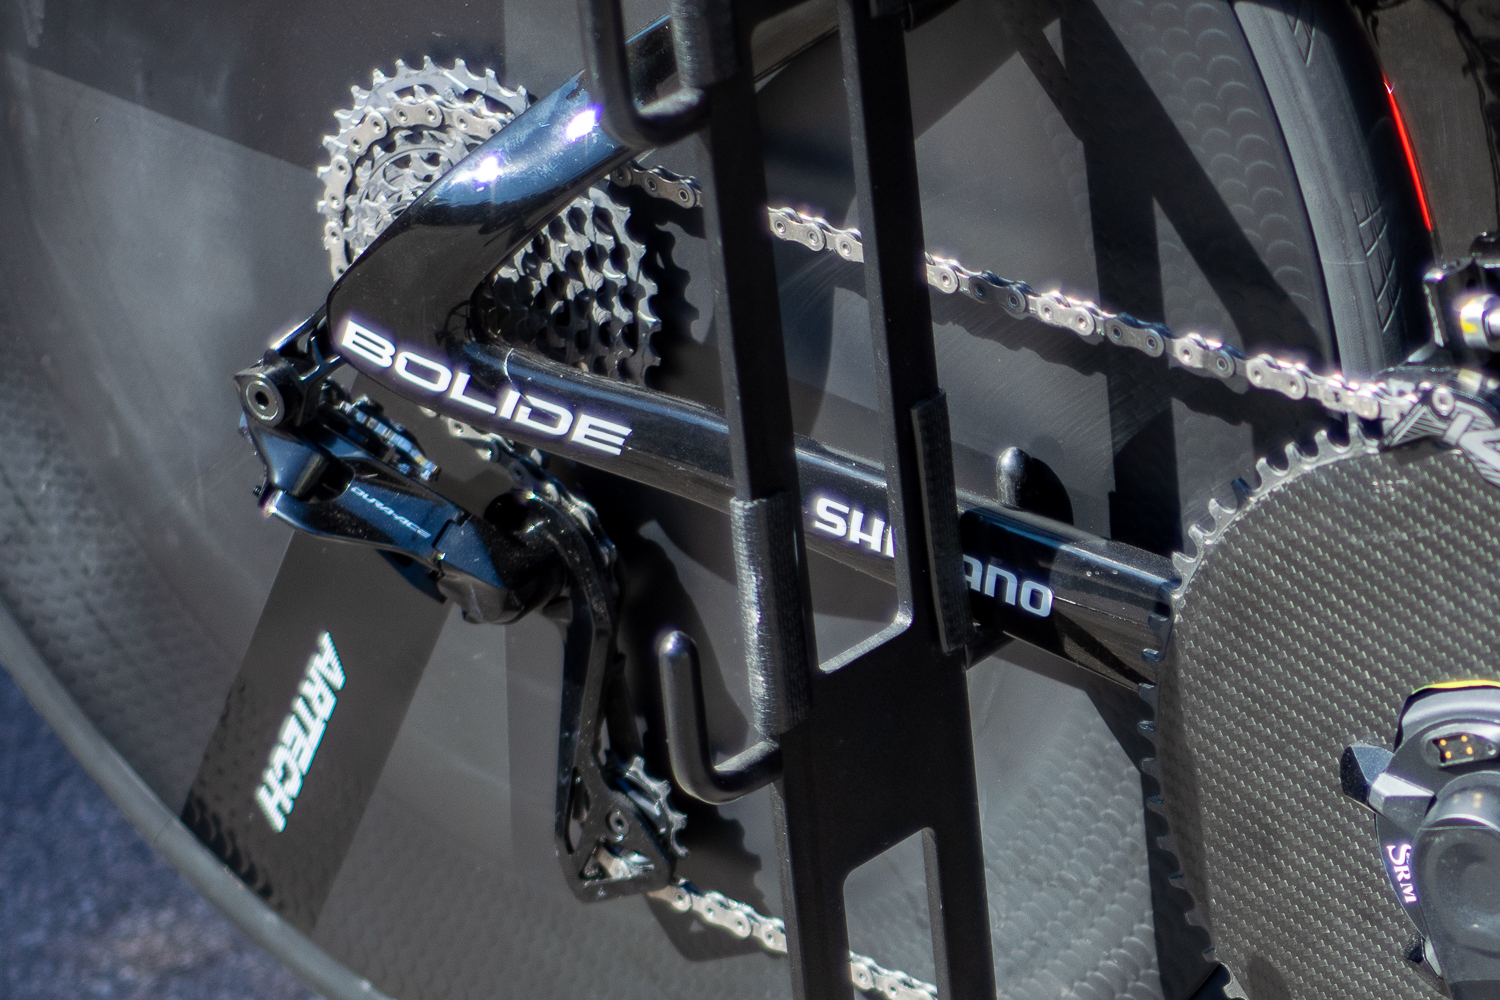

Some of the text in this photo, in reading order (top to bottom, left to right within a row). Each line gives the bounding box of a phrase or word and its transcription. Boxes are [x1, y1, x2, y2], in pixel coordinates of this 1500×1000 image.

[340, 319, 634, 456] BOLIDE
[350, 486, 432, 539] DURA-ACE
[814, 497, 1053, 618] SHANO
[256, 630, 346, 834] ARTECH
[1386, 843, 1417, 904] SRM
